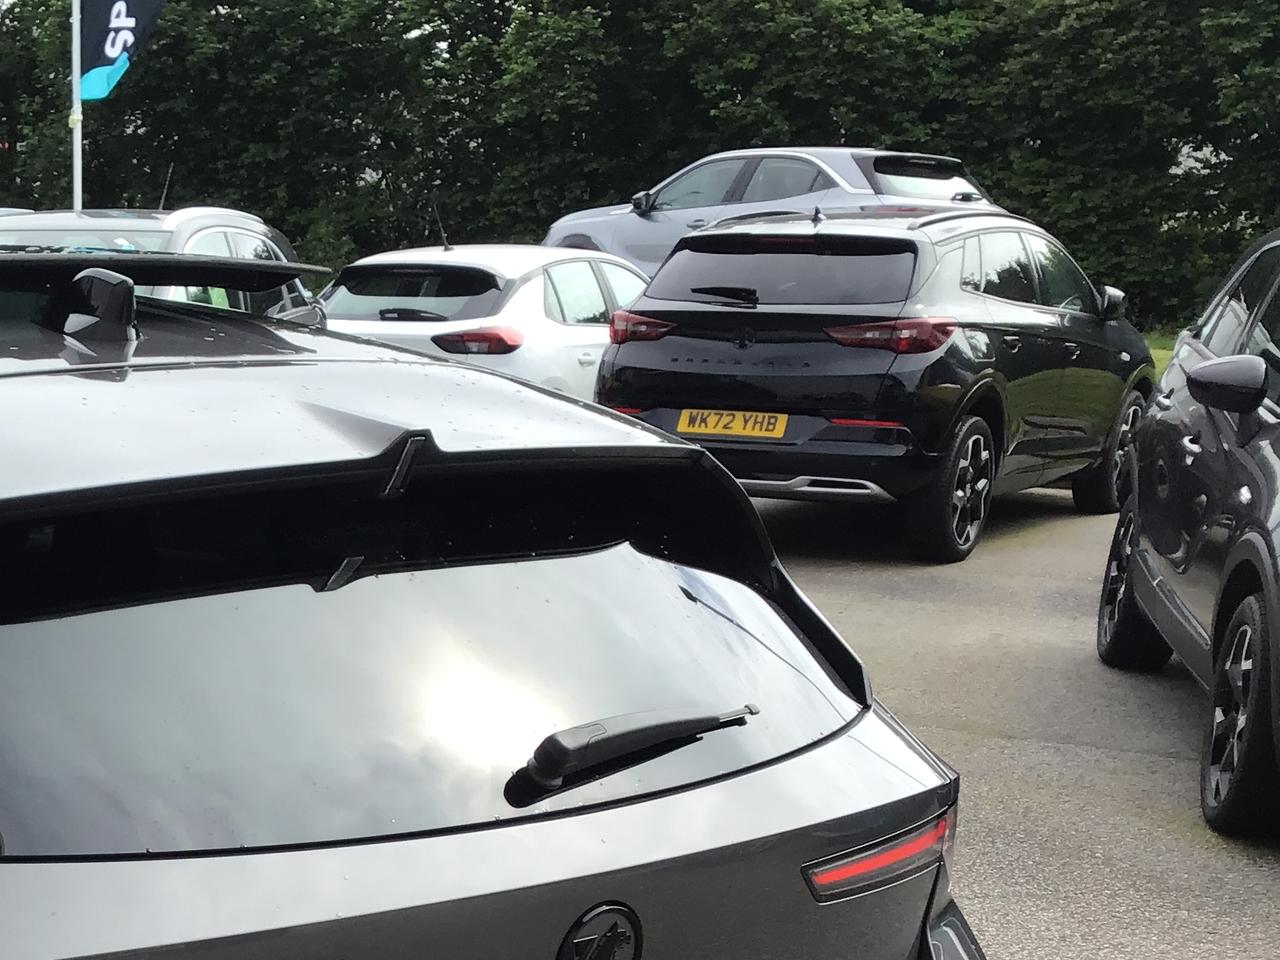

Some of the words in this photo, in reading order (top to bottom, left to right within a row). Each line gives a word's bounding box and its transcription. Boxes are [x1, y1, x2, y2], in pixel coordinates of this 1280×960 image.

[104, 0, 136, 58] SP
[687, 411, 736, 430] WK72
[742, 413, 779, 433] YHB
